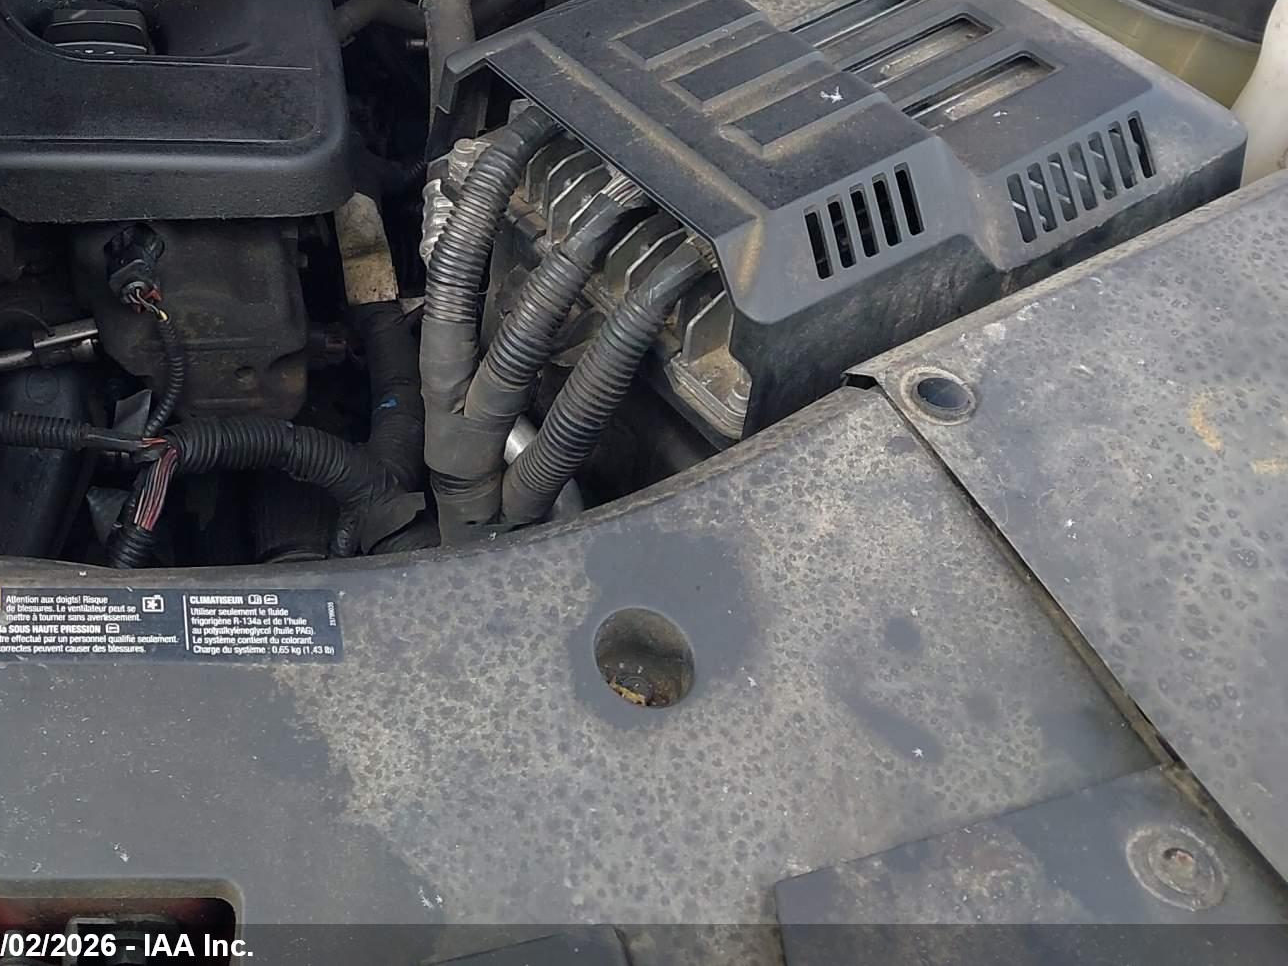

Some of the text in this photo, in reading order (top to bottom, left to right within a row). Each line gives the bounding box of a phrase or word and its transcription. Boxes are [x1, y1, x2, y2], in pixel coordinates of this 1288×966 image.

[6, 595, 108, 605] Attention aux doigts! Risque
[190, 596, 244, 604] CLIMATISEUR
[108, 606, 125, 614] peut
[218, 608, 258, 616] seulement
[258, 608, 266, 616] le
[268, 608, 288, 616] fluide
[6, 613, 142, 622] mettre à tourner sans avertissement.
[190, 616, 308, 626] frigorigène R-134a et de l'huile
[8, 624, 31, 633] SOUS
[32, 625, 59, 633] HAUTE
[60, 625, 101, 633] PRESSION
[273, 627, 294, 636] (huile
[11, 634, 42, 642] effectué
[43, 636, 56, 644] par
[70, 636, 106, 644] personnel
[108, 634, 136, 644] qualifié
[192, 636, 314, 645] Le système contient du colorant.
[33, 645, 64, 654] peuvent
[92, 644, 106, 652] des
[193, 645, 220, 655] Charge
[222, 645, 232, 654] du
[234, 645, 266, 655] système
[292, 646, 302, 655] kg
